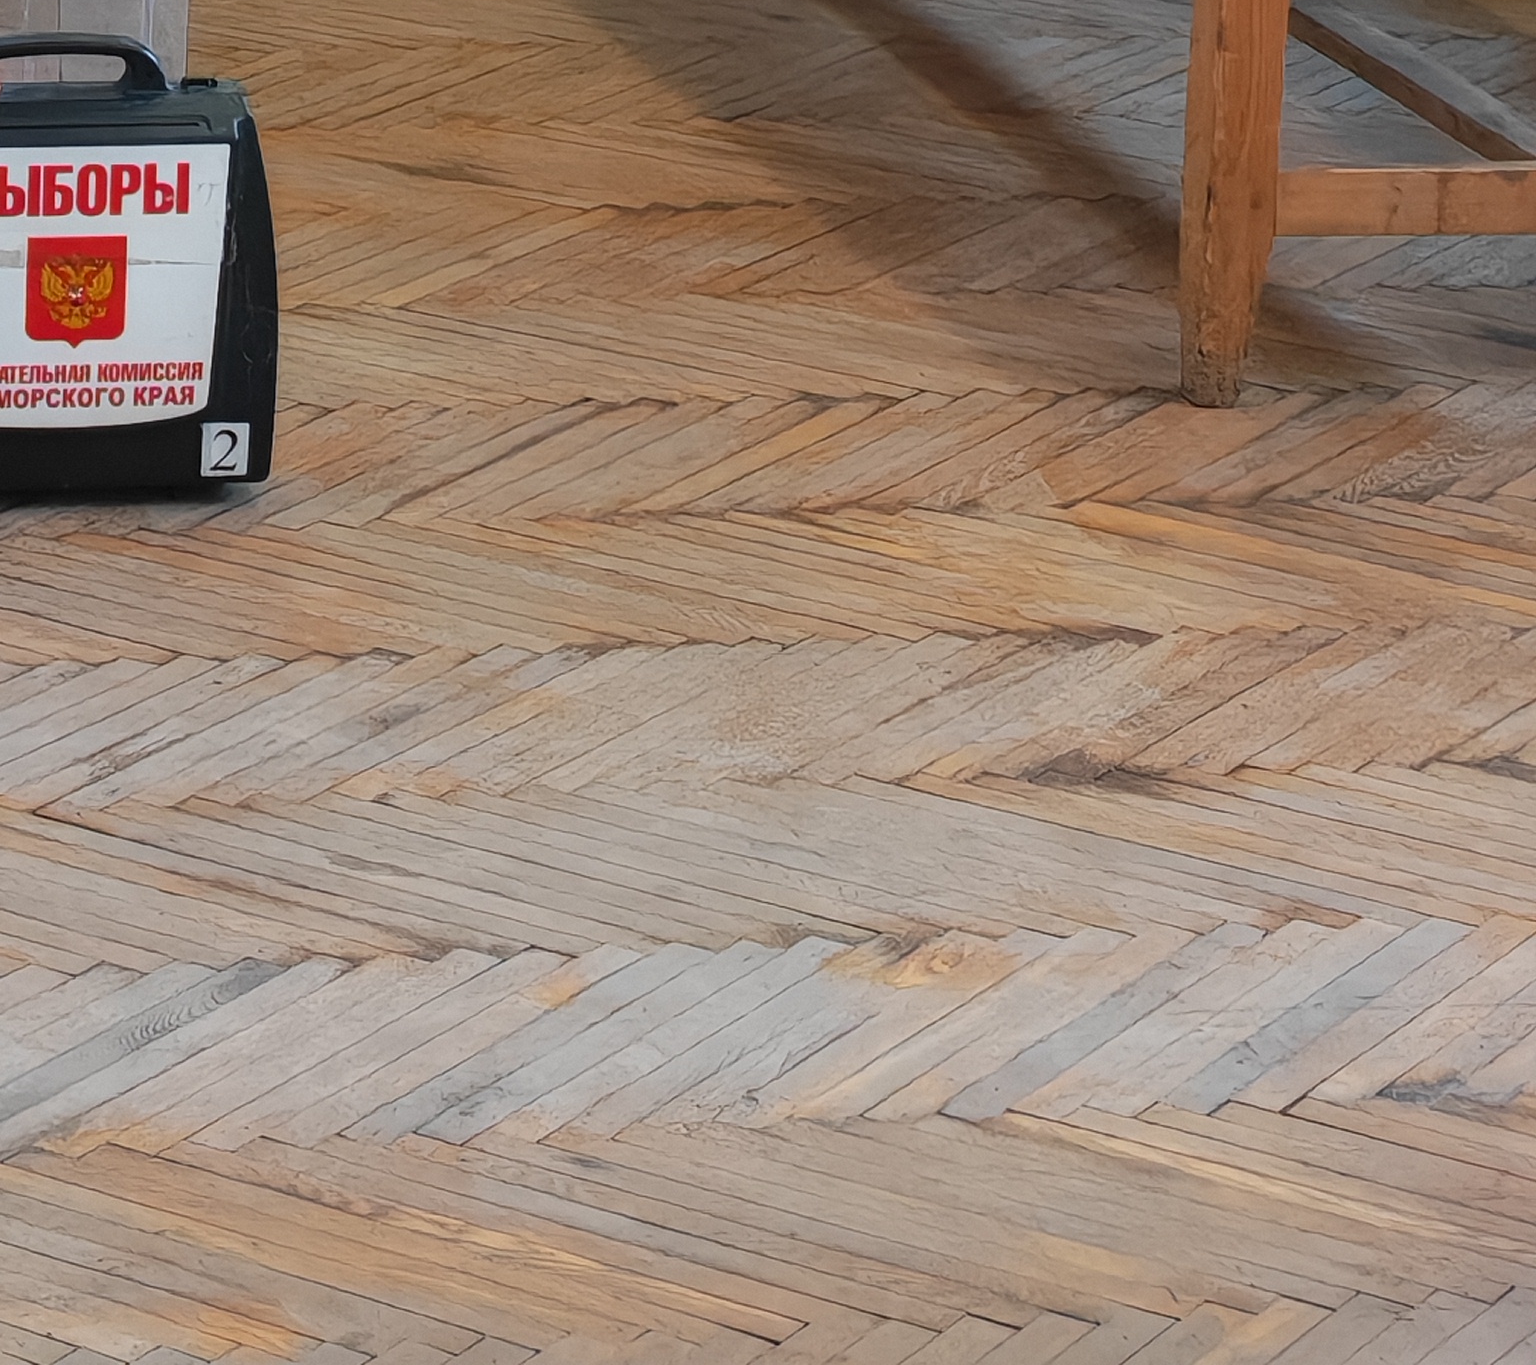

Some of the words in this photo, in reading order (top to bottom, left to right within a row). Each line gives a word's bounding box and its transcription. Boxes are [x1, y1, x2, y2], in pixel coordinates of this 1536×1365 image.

[97, 361, 204, 383] КОМИССИЯ
[133, 385, 195, 407] КРАЯ
[209, 429, 239, 472] 2
